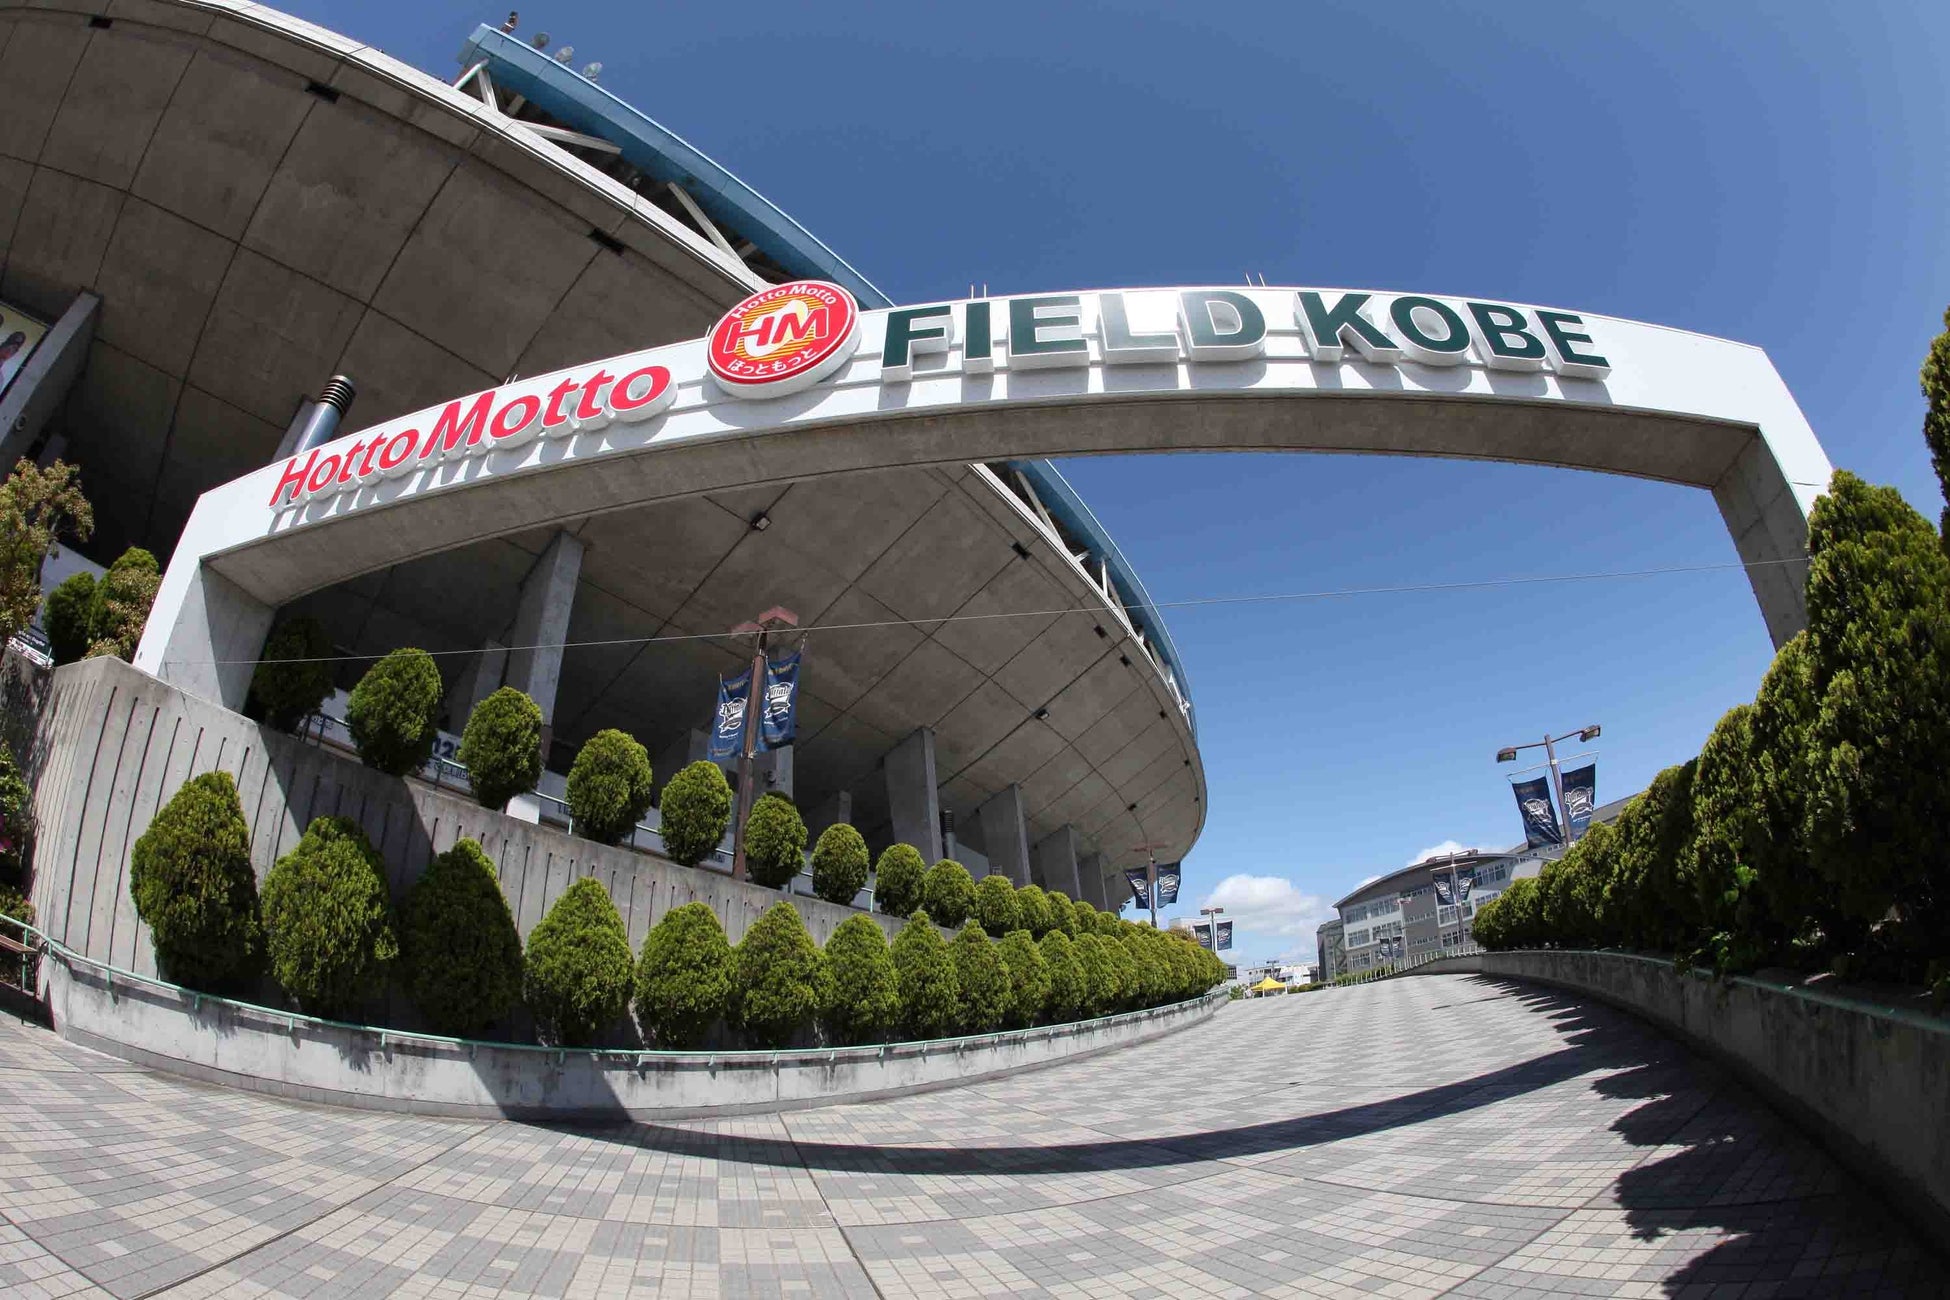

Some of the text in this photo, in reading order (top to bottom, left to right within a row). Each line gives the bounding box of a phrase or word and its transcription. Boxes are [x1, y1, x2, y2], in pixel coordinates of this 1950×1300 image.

[723, 306, 829, 354] HM
[881, 291, 1608, 369] FIELD KOBE
[727, 348, 817, 375] ほっともっと
